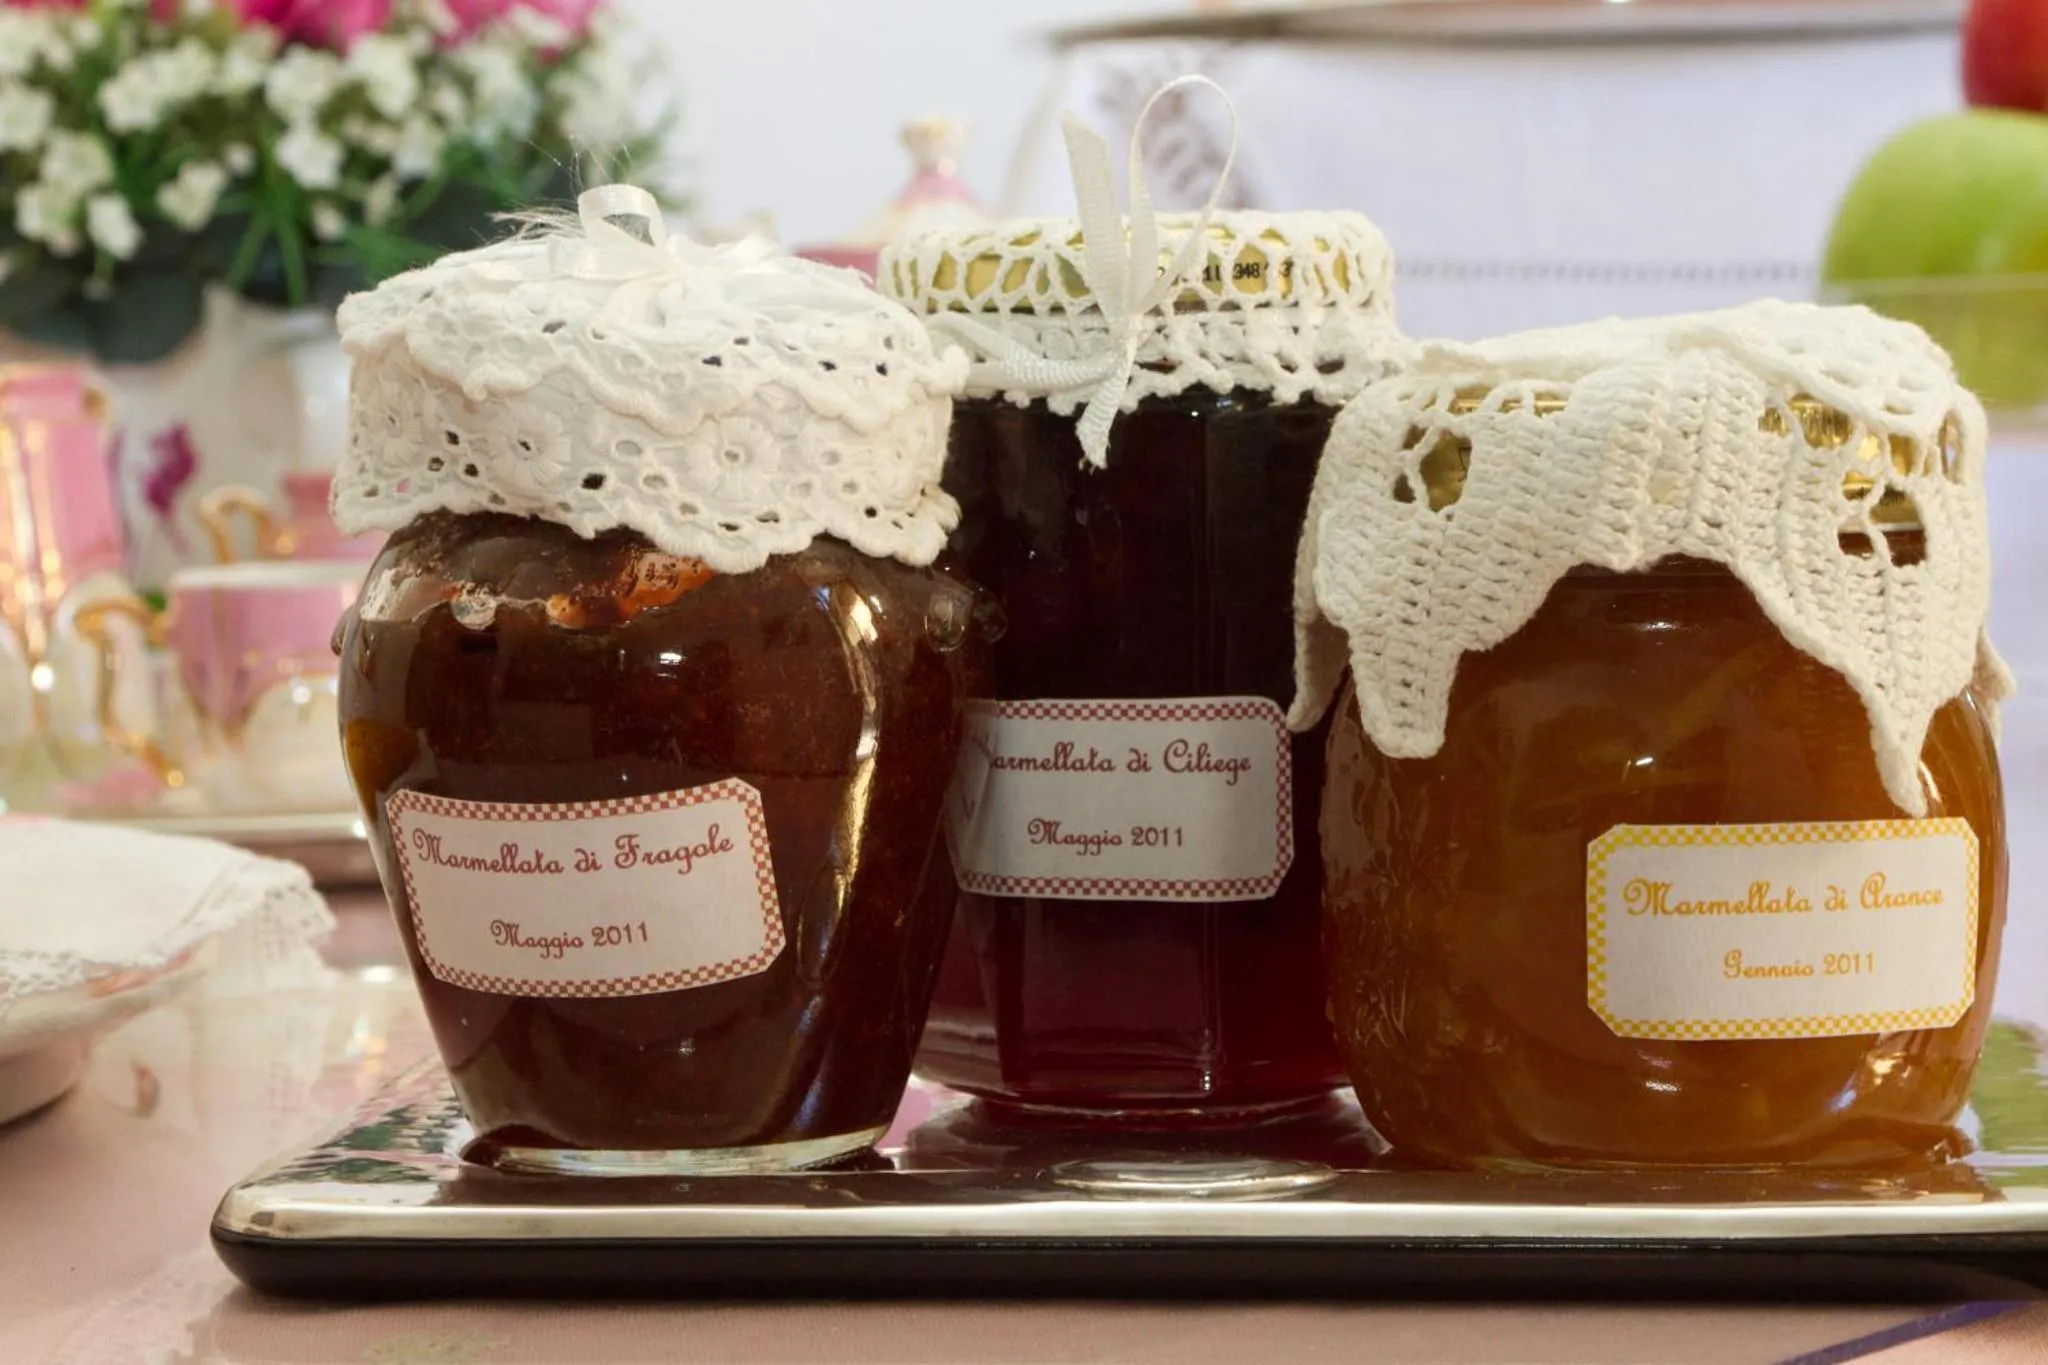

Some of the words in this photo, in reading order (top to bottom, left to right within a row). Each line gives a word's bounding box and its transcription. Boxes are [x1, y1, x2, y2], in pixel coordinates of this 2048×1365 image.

[973, 740, 1116, 773] armellata
[1126, 748, 1153, 773] di
[1163, 738, 1252, 786] Ciliege
[413, 828, 564, 874] Marmellata
[574, 848, 602, 873] di
[615, 823, 734, 875] Fragole
[1027, 818, 1123, 856] Maggio
[1131, 827, 1183, 846] 2011
[1623, 877, 1813, 917] Marmellata
[1823, 885, 1849, 911] di
[1859, 871, 1943, 910] Arance
[490, 919, 584, 959] Maggio
[591, 921, 648, 947] 2011
[1723, 949, 1814, 979] Gennaio
[1823, 952, 1875, 976] 2011
